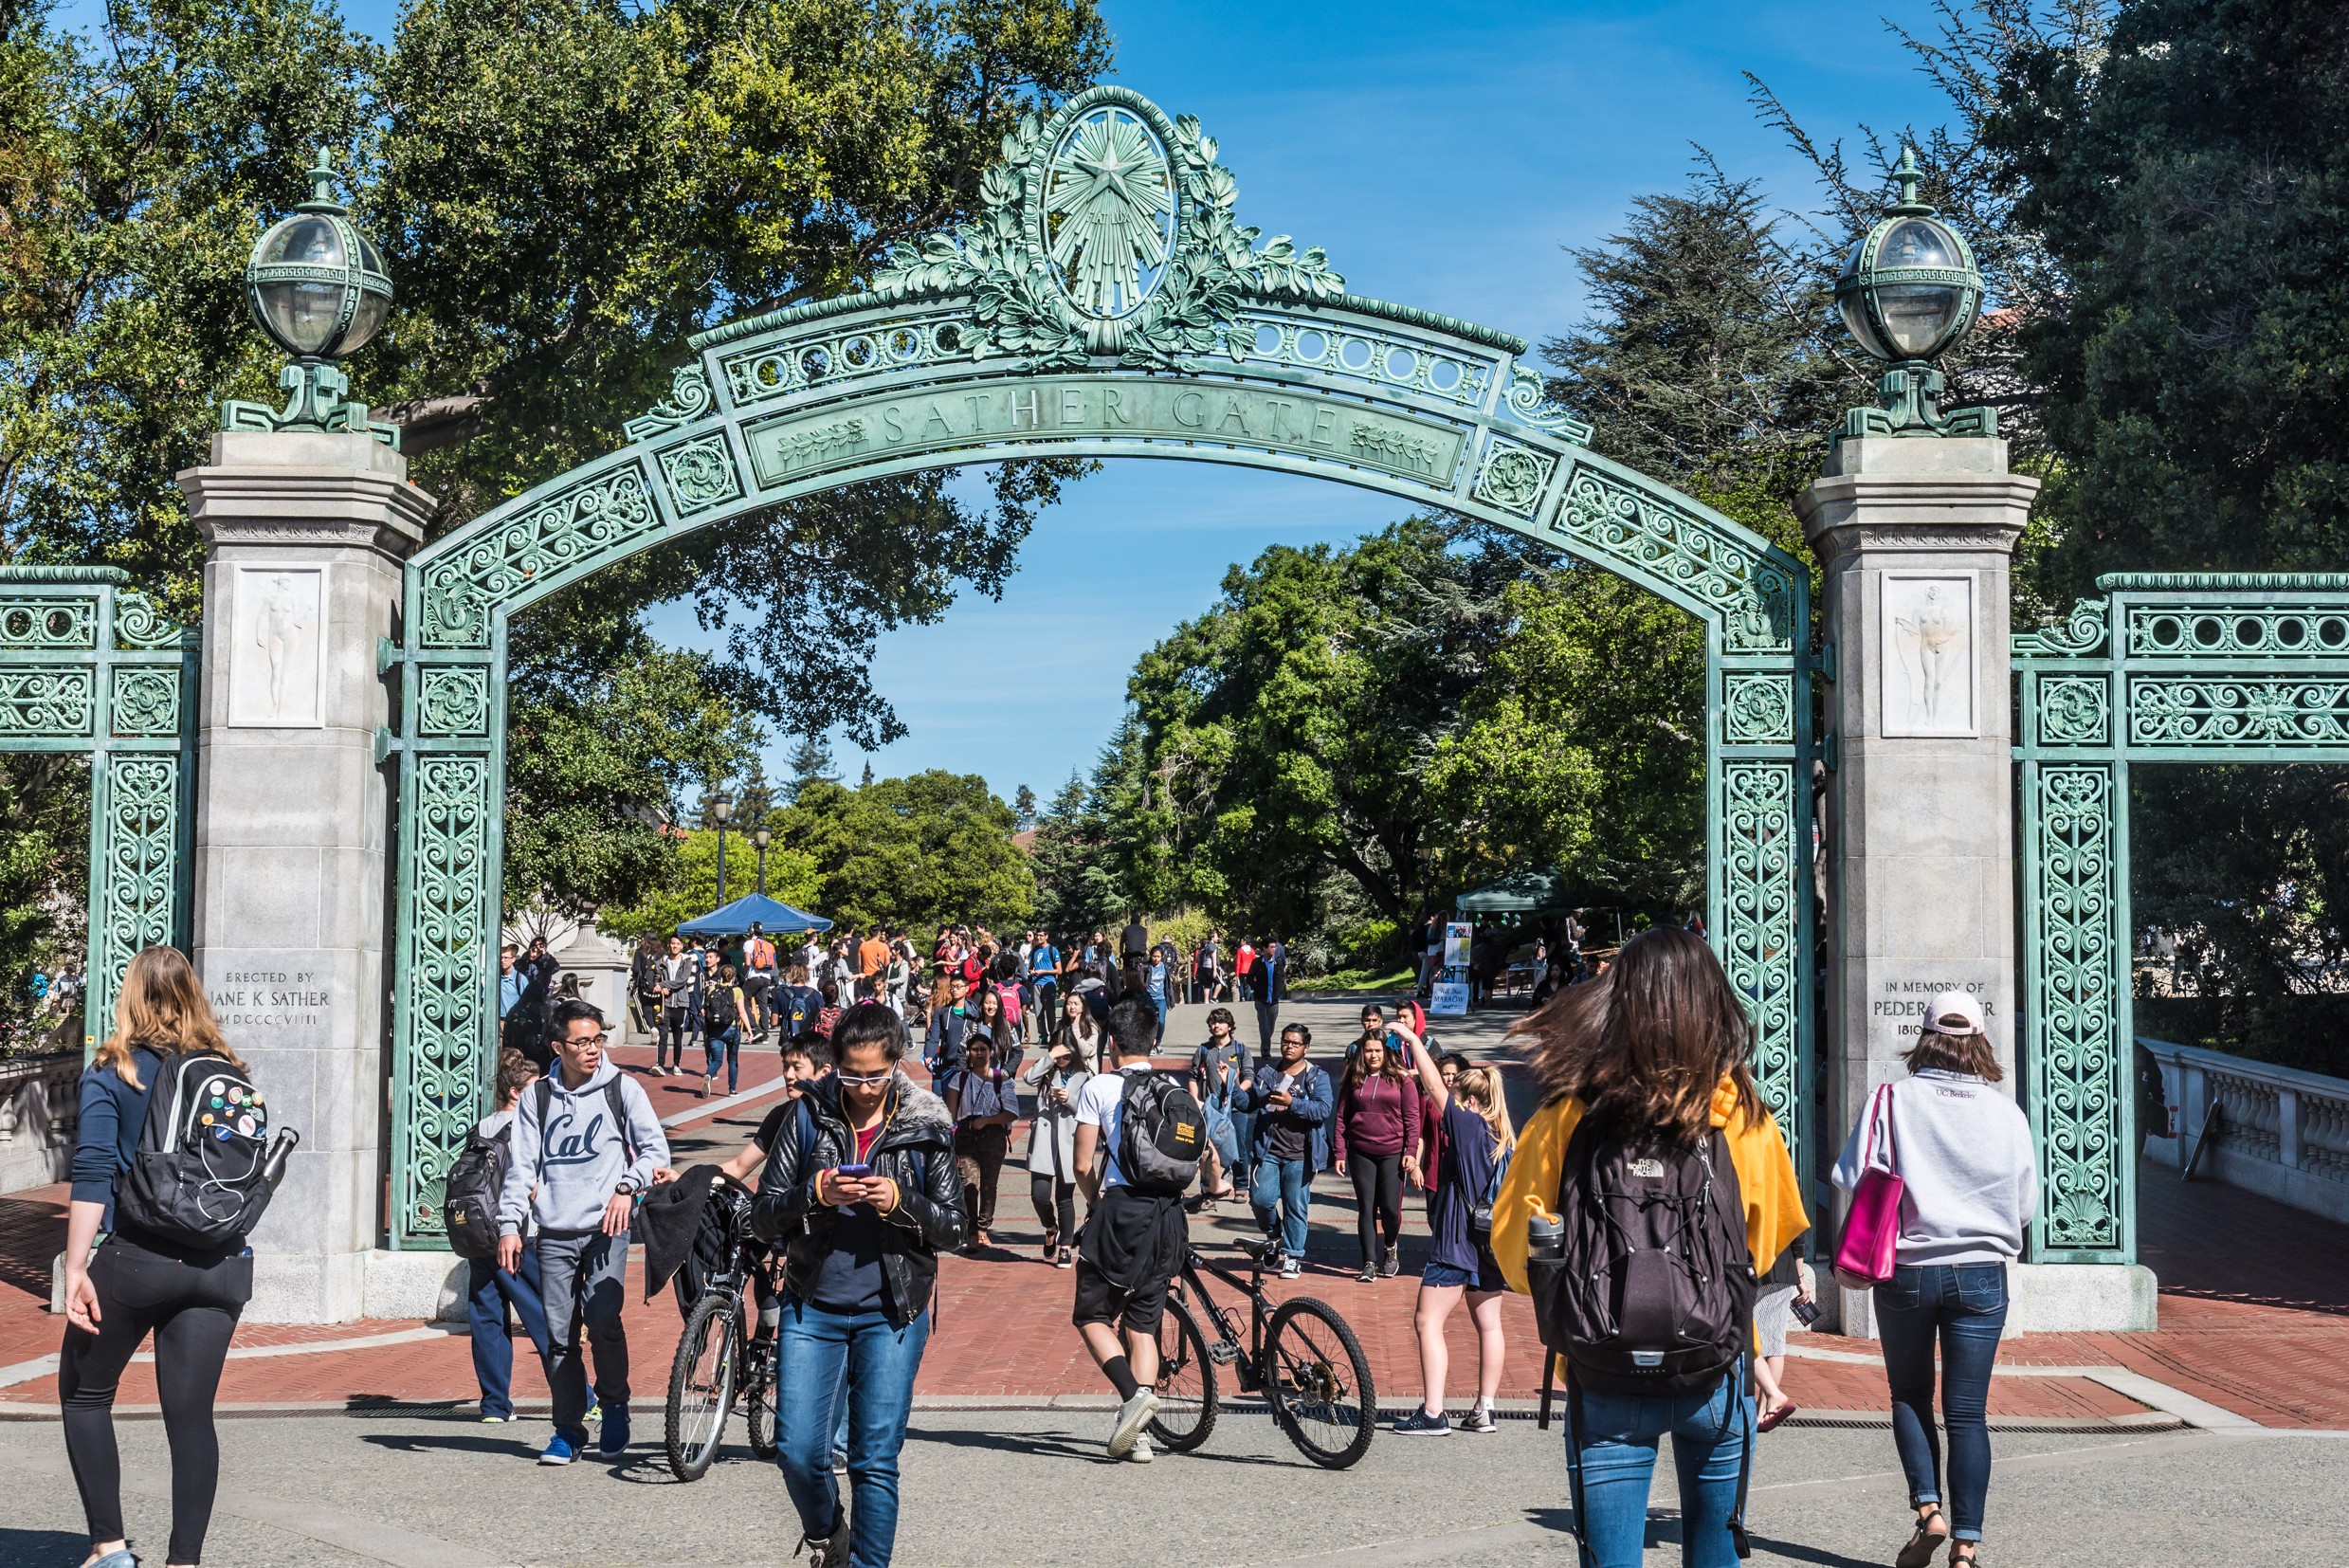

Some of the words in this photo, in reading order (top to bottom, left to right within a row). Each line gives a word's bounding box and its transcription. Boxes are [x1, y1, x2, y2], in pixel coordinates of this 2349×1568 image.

[1086, 211, 1108, 225] FIAT
[1111, 212, 1132, 225] LUX
[883, 388, 1131, 443] SATHER
[1173, 391, 1337, 447] GATE
[226, 972, 286, 983] ERECTED
[297, 972, 314, 983] BY
[1885, 982, 1898, 993] IN
[1903, 982, 1960, 994] MEMORY
[1966, 983, 1984, 993] OF
[209, 992, 246, 1006] JANE
[253, 992, 264, 1006] K
[271, 992, 331, 1007] SATHER
[1874, 1001, 1926, 1016] PEDER
[1898, 1025, 1922, 1035] 1810
[1950, 1089, 1976, 1100] Berkeley
[544, 1113, 604, 1166] Cal
[1627, 1162, 1651, 1172] NORTH
